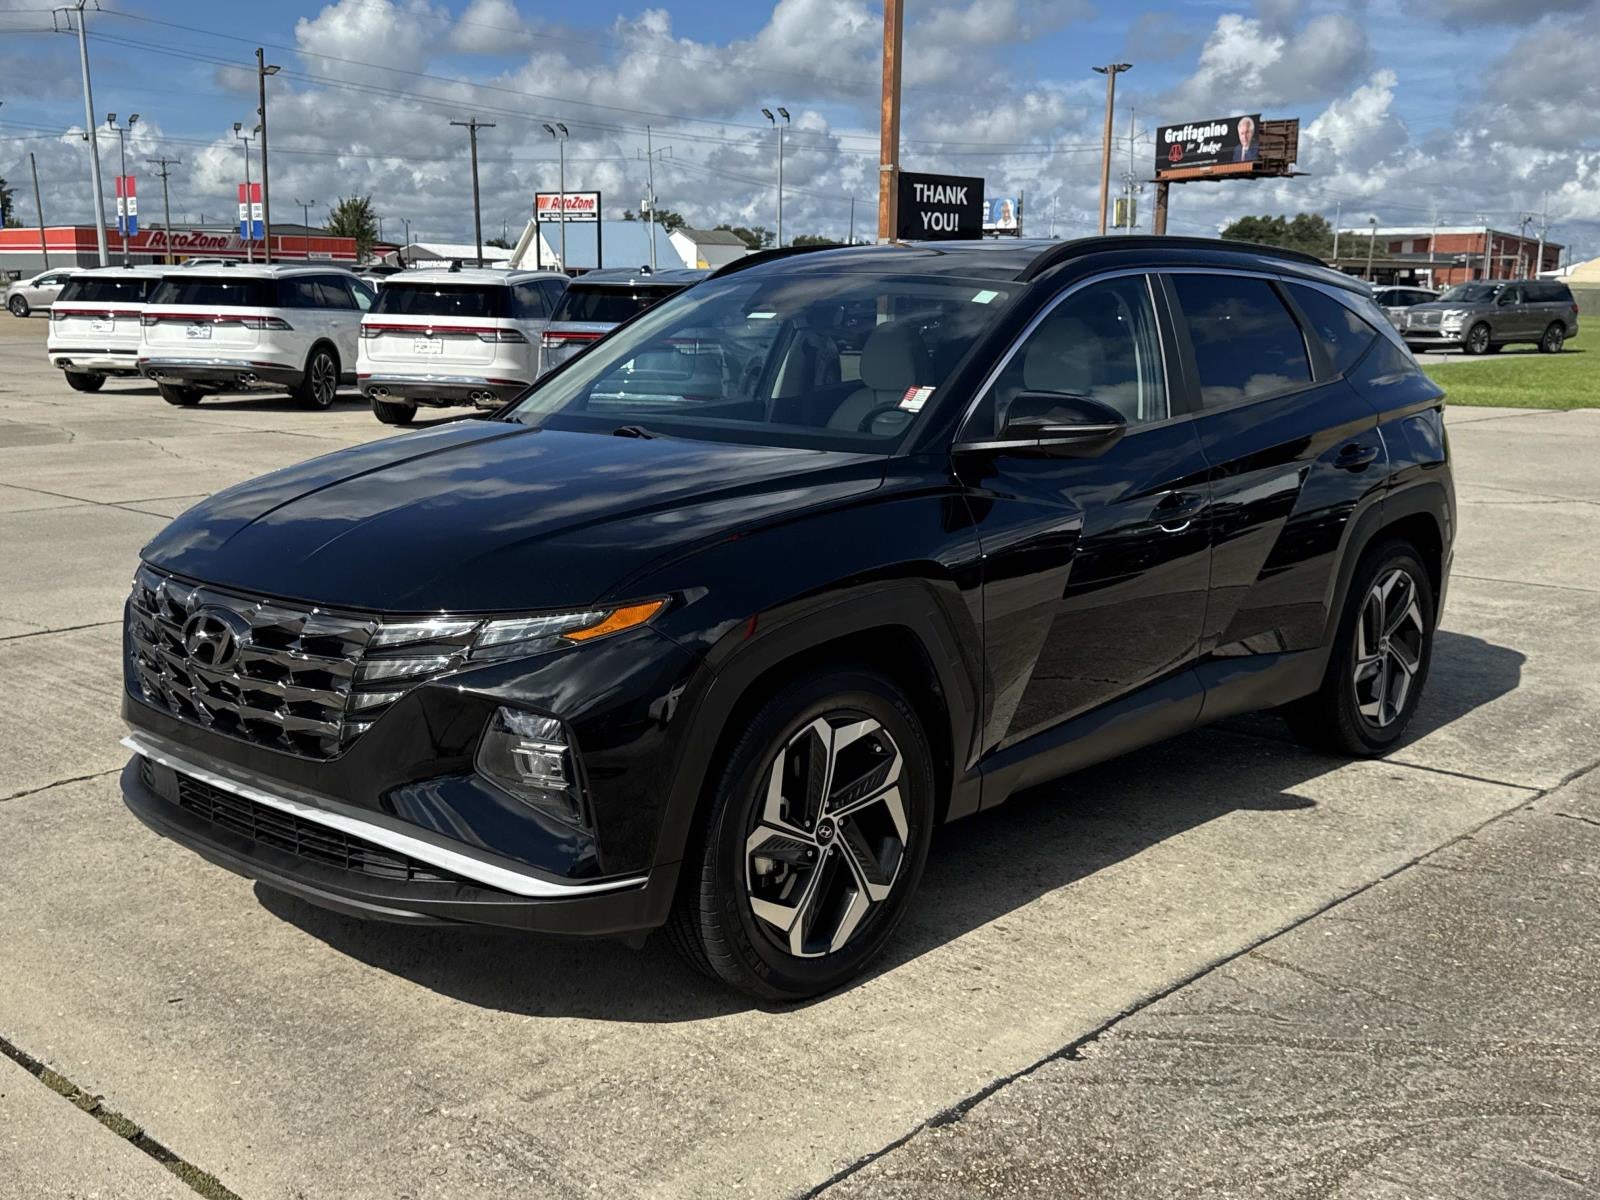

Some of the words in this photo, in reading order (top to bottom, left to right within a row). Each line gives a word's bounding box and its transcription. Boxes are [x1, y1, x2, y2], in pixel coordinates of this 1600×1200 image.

[1164, 122, 1228, 143] Graffagnino
[1196, 140, 1222, 155] Judge
[913, 183, 968, 205] THANK
[920, 211, 959, 232] YOU!
